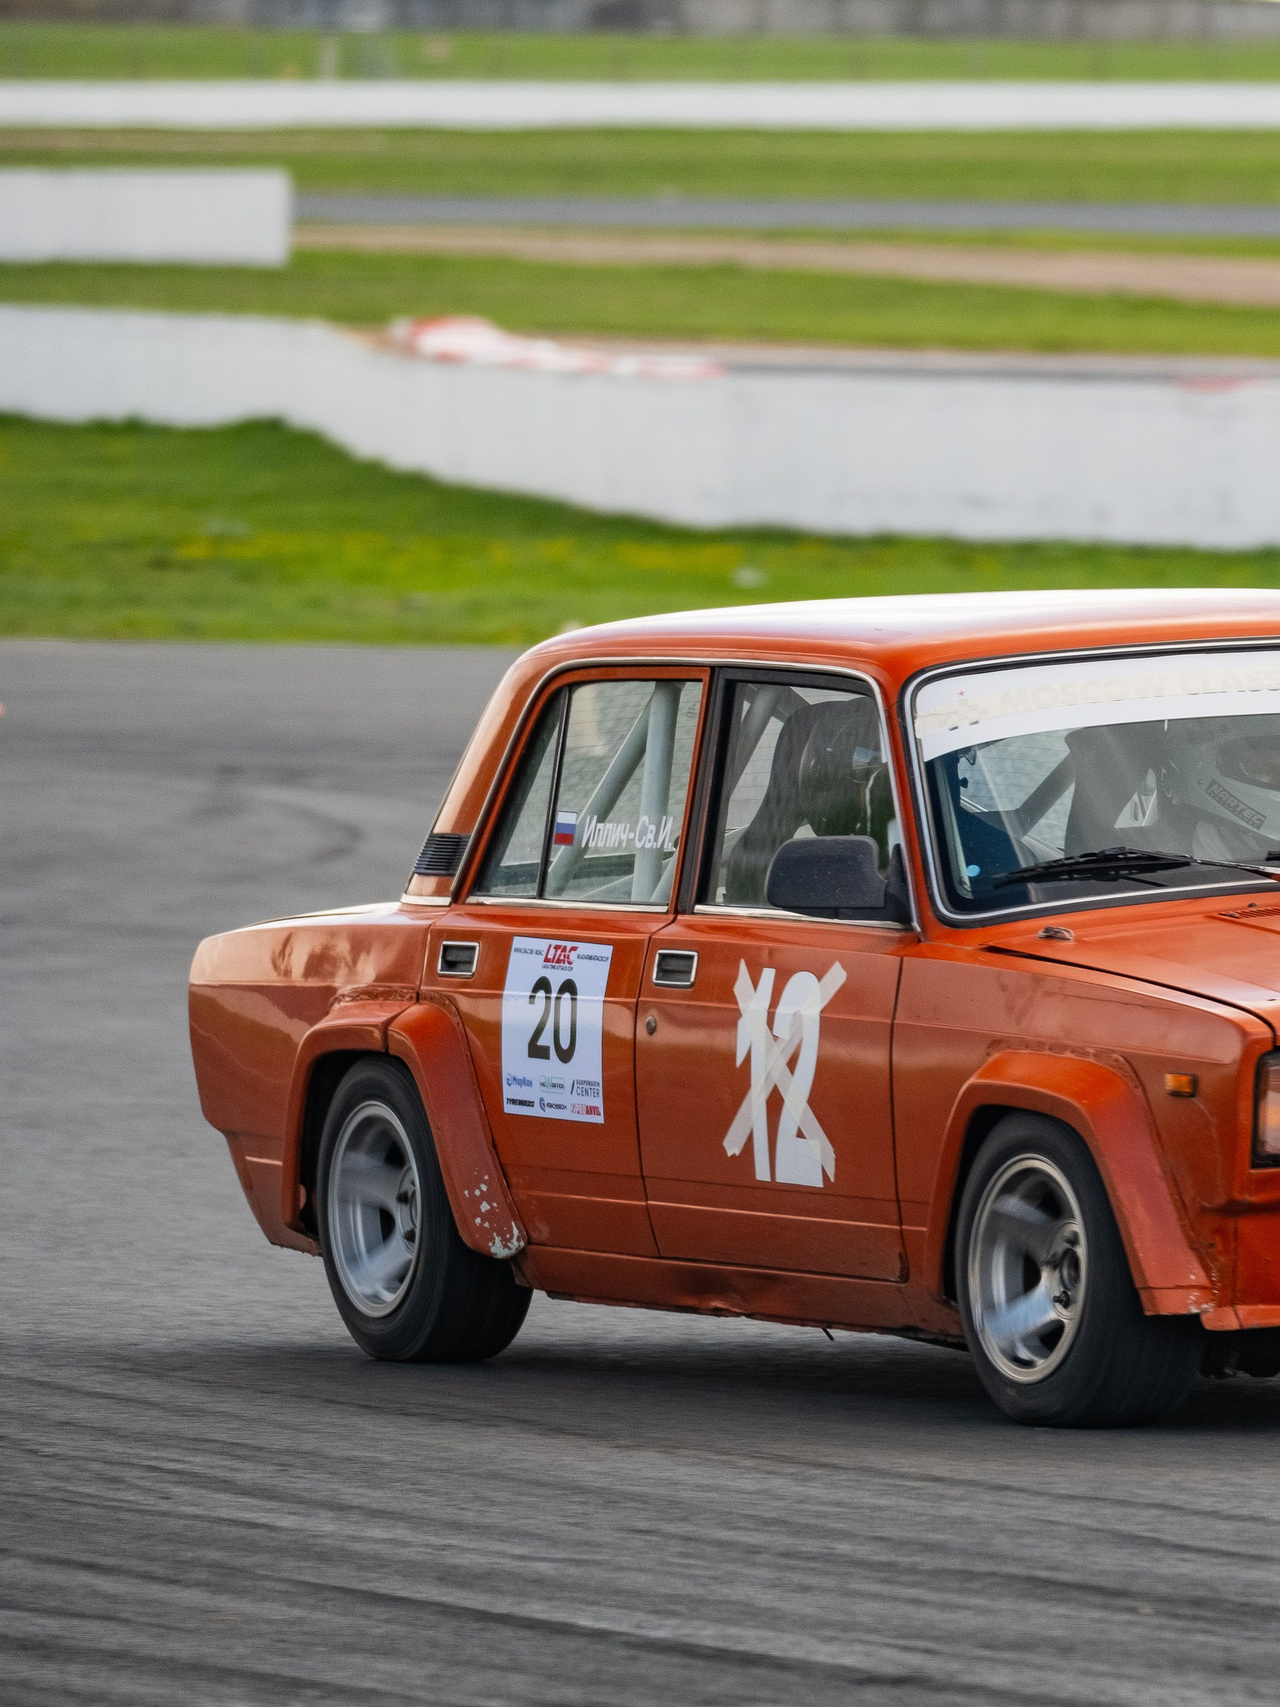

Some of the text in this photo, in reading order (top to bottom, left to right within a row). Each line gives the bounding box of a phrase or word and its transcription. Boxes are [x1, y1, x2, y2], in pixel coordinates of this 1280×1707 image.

[1000, 674, 1170, 711] MOSCOW
[543, 943, 579, 965] LTAC
[527, 975, 578, 1064] 20
[576, 1086, 600, 1098] CENTER
